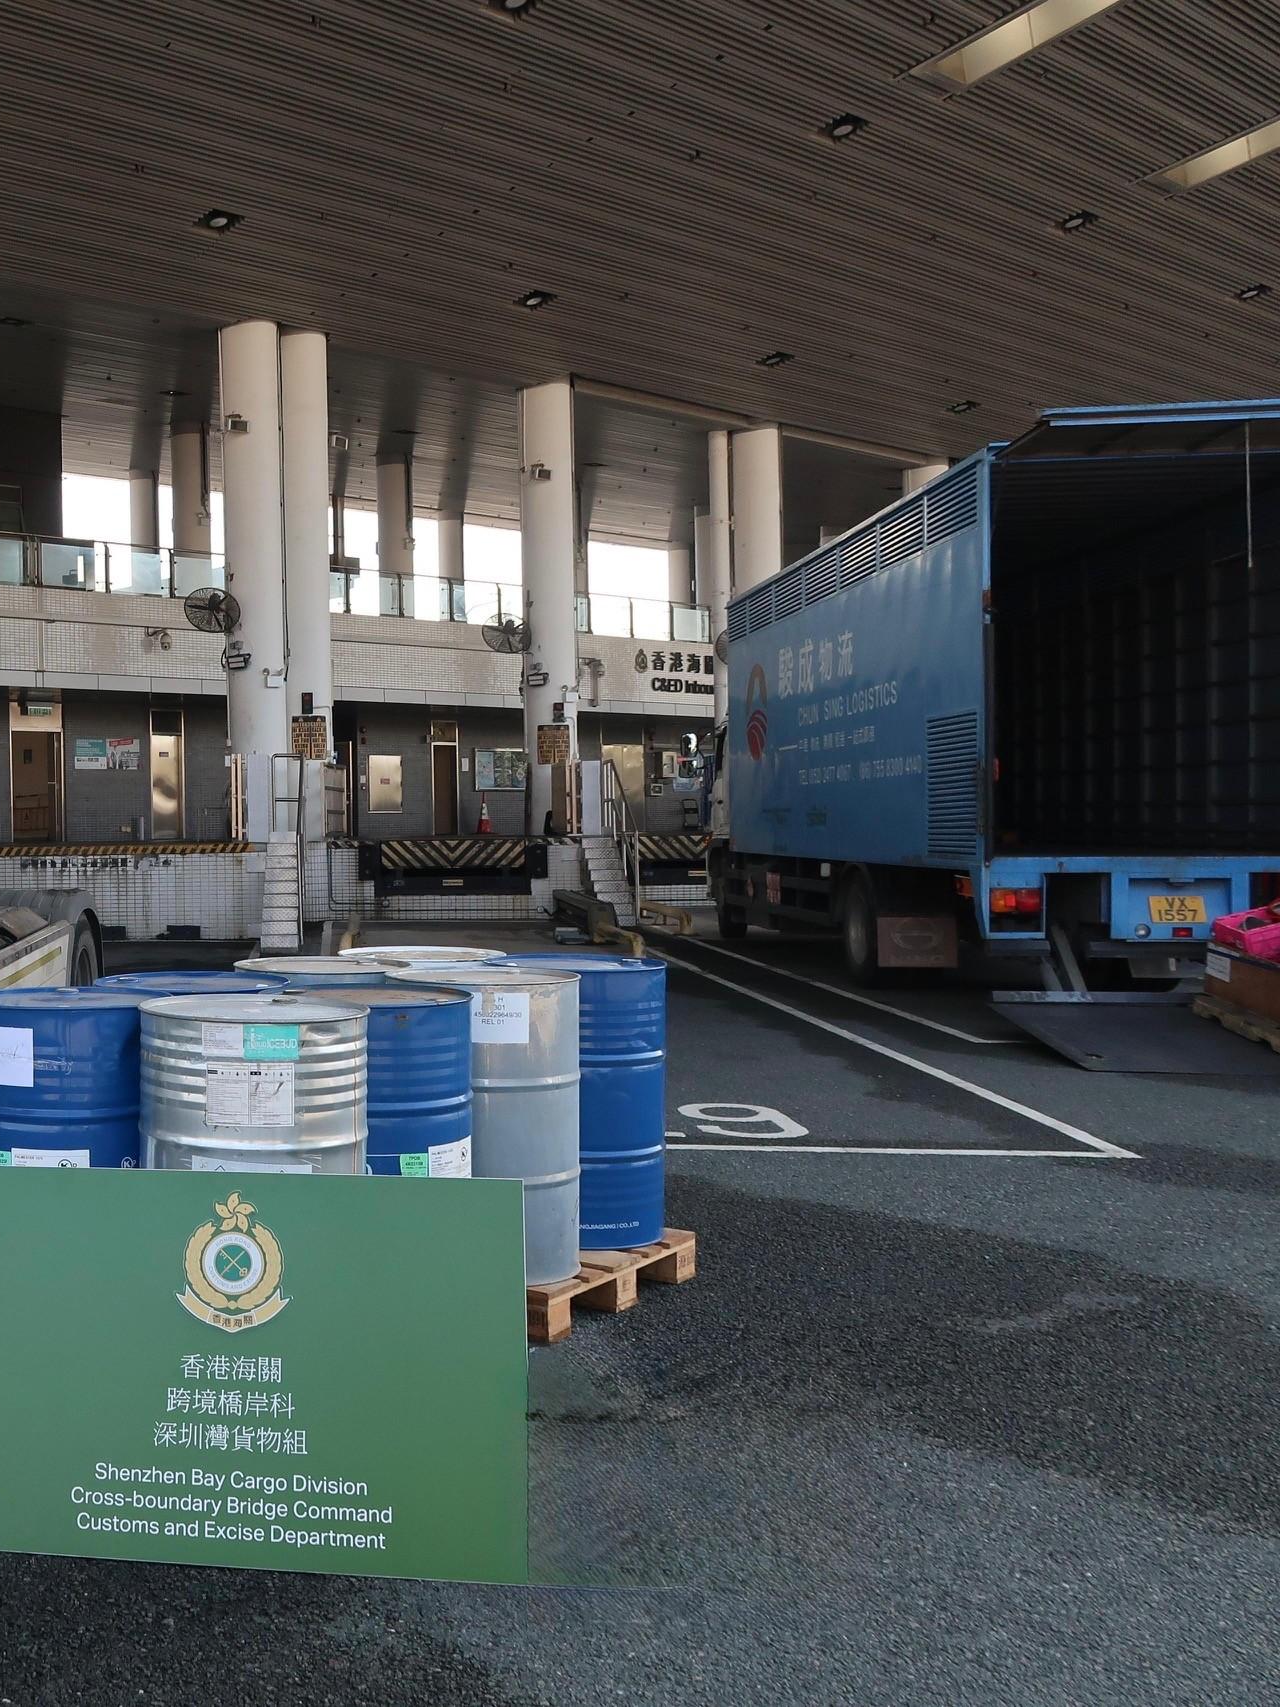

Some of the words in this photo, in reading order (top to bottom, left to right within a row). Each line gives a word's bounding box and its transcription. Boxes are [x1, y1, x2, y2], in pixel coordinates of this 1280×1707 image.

[651, 678, 683, 693] C&ED
[824, 696, 844, 721] SING
[846, 681, 898, 716] LOGISTICS
[1158, 909, 1198, 921] 1557
[1165, 897, 1188, 909] VX
[180, 1353, 283, 1383] 香港海關
[166, 1387, 295, 1420] 跨境橋岸科
[153, 1421, 308, 1455] 深圳灣貨物組
[95, 1463, 186, 1486] Shenzhen
[191, 1469, 226, 1491] Bay
[230, 1471, 287, 1494] Cargo
[293, 1475, 368, 1496] Division
[71, 1486, 221, 1516] Cross-boundary
[227, 1497, 288, 1519] Bridge
[293, 1501, 393, 1524] Command
[76, 1512, 160, 1535] Customs
[164, 1519, 199, 1538] and
[204, 1522, 264, 1542] Excise
[270, 1526, 386, 1550] Department
